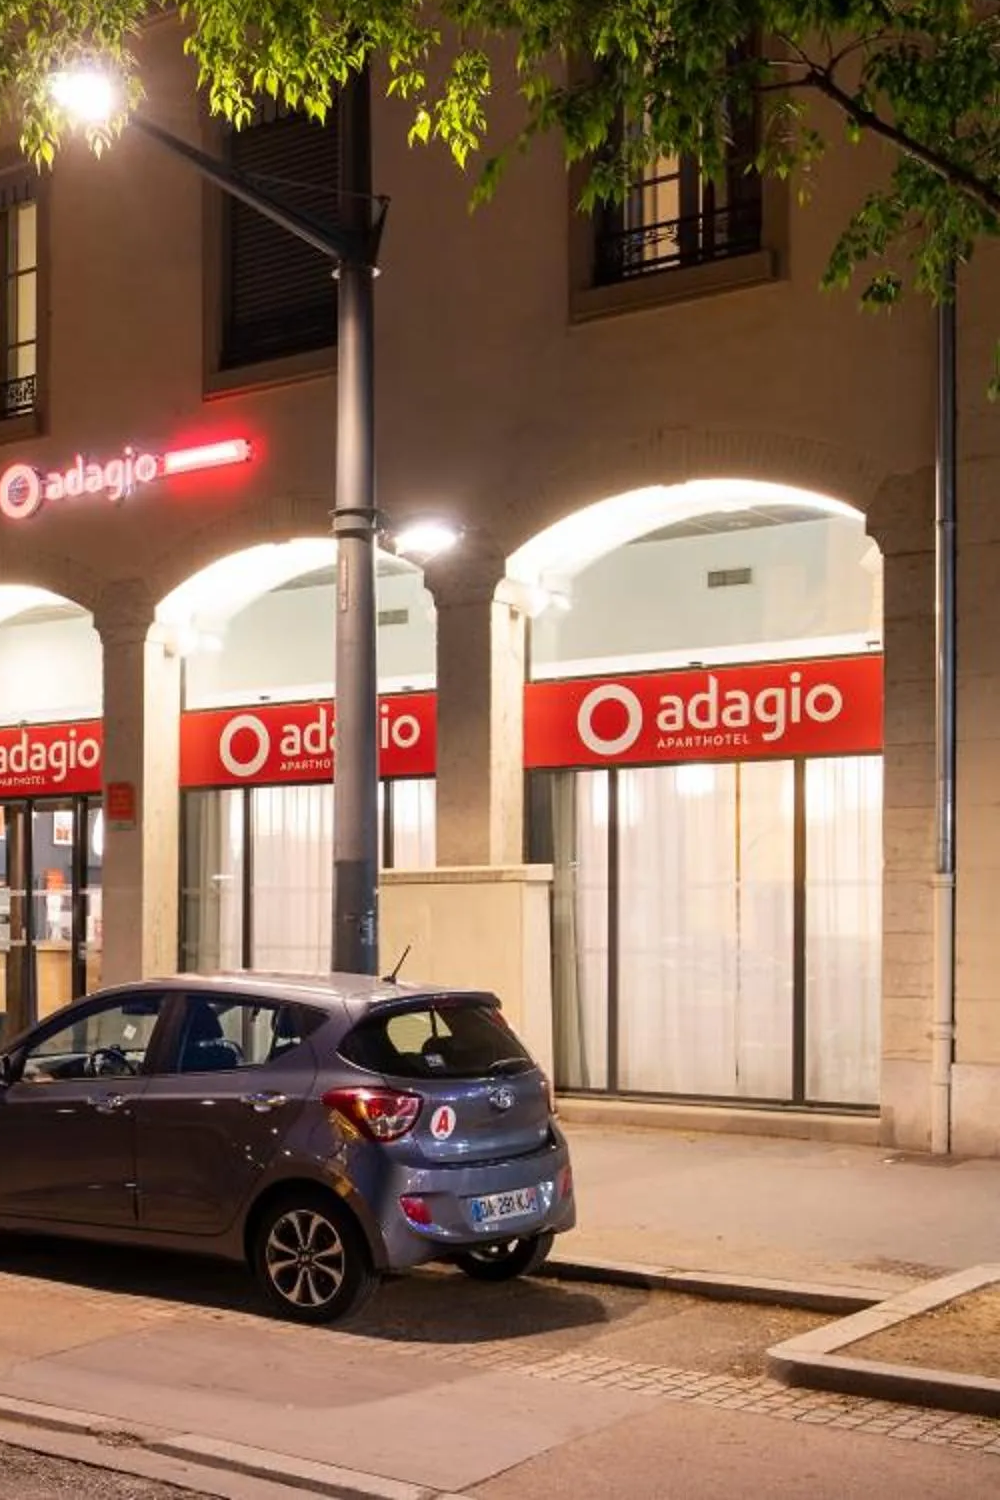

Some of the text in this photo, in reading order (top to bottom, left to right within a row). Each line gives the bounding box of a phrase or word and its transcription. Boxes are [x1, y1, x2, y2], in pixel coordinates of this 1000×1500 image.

[46, 446, 157, 501] adagio
[656, 672, 842, 741] adagio
[280, 703, 421, 757] adio
[657, 734, 750, 749] APARTHOTEL
[279, 759, 332, 771] APARTHO
[436, 1110, 449, 1133] A
